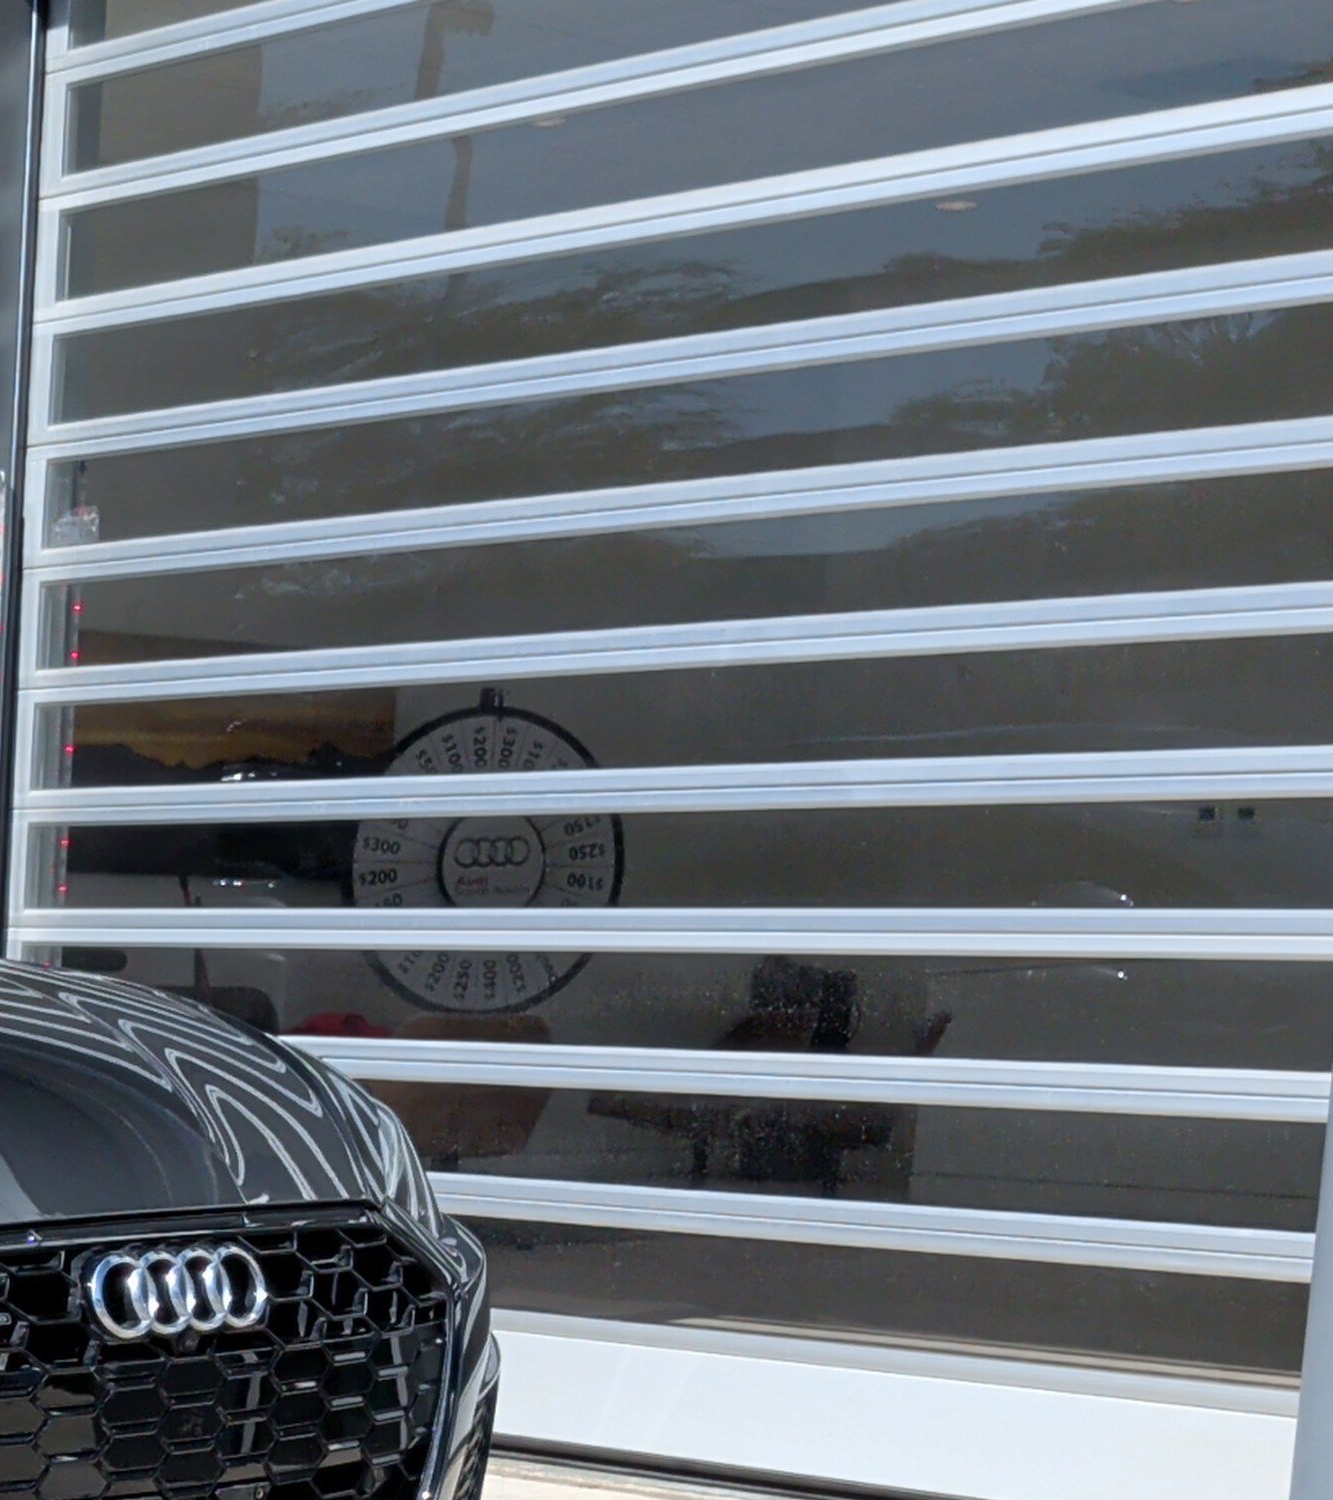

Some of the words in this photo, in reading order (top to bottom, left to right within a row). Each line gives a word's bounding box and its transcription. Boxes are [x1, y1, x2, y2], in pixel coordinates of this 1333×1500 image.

[473, 727, 487, 769] $200
[498, 727, 517, 769] $300
[363, 836, 401, 854] $300
[569, 843, 605, 860] $250
[359, 868, 398, 886] $200
[567, 873, 603, 891] $100
[453, 959, 472, 1000] $250
